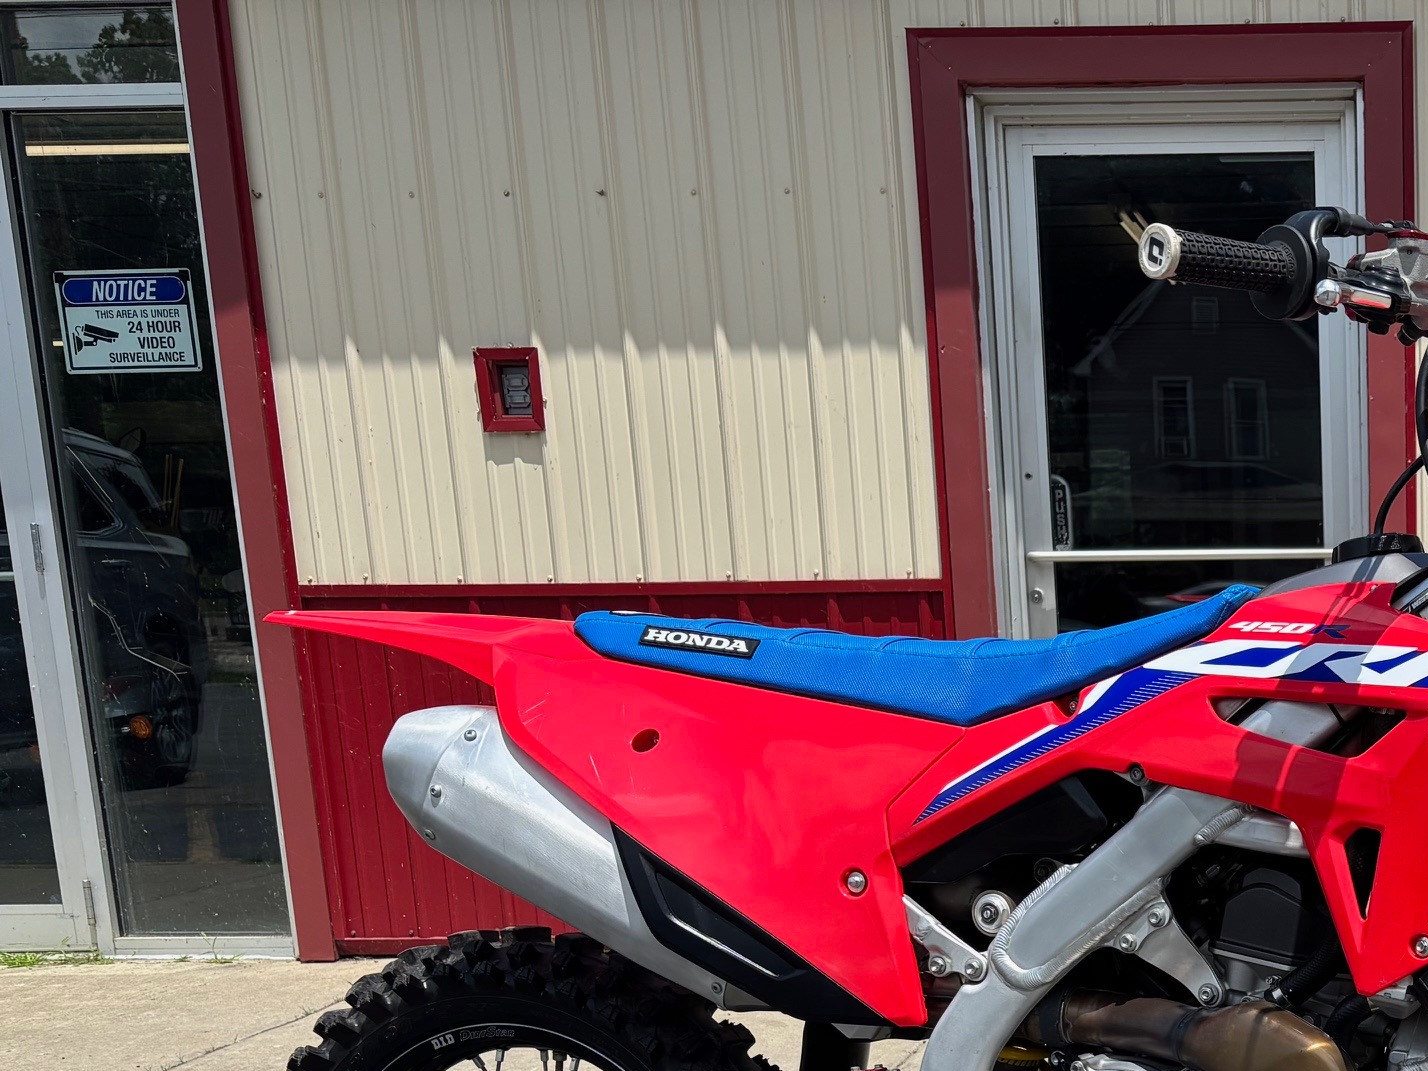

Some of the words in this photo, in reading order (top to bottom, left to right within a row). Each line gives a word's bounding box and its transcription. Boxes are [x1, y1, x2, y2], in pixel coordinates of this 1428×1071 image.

[92, 279, 157, 301] NOTICE
[95, 310, 114, 319] THIS
[116, 310, 138, 319] AREA
[140, 309, 149, 318] IS
[151, 308, 180, 318] UNDER
[128, 321, 143, 334] 24
[147, 320, 182, 334] HOUR
[138, 336, 176, 349] VIDEO
[109, 352, 186, 364] SURVEILLANCE
[1054, 489, 1067, 538] PUSH
[1228, 621, 1350, 639] 450R
[644, 628, 749, 652] HONDA
